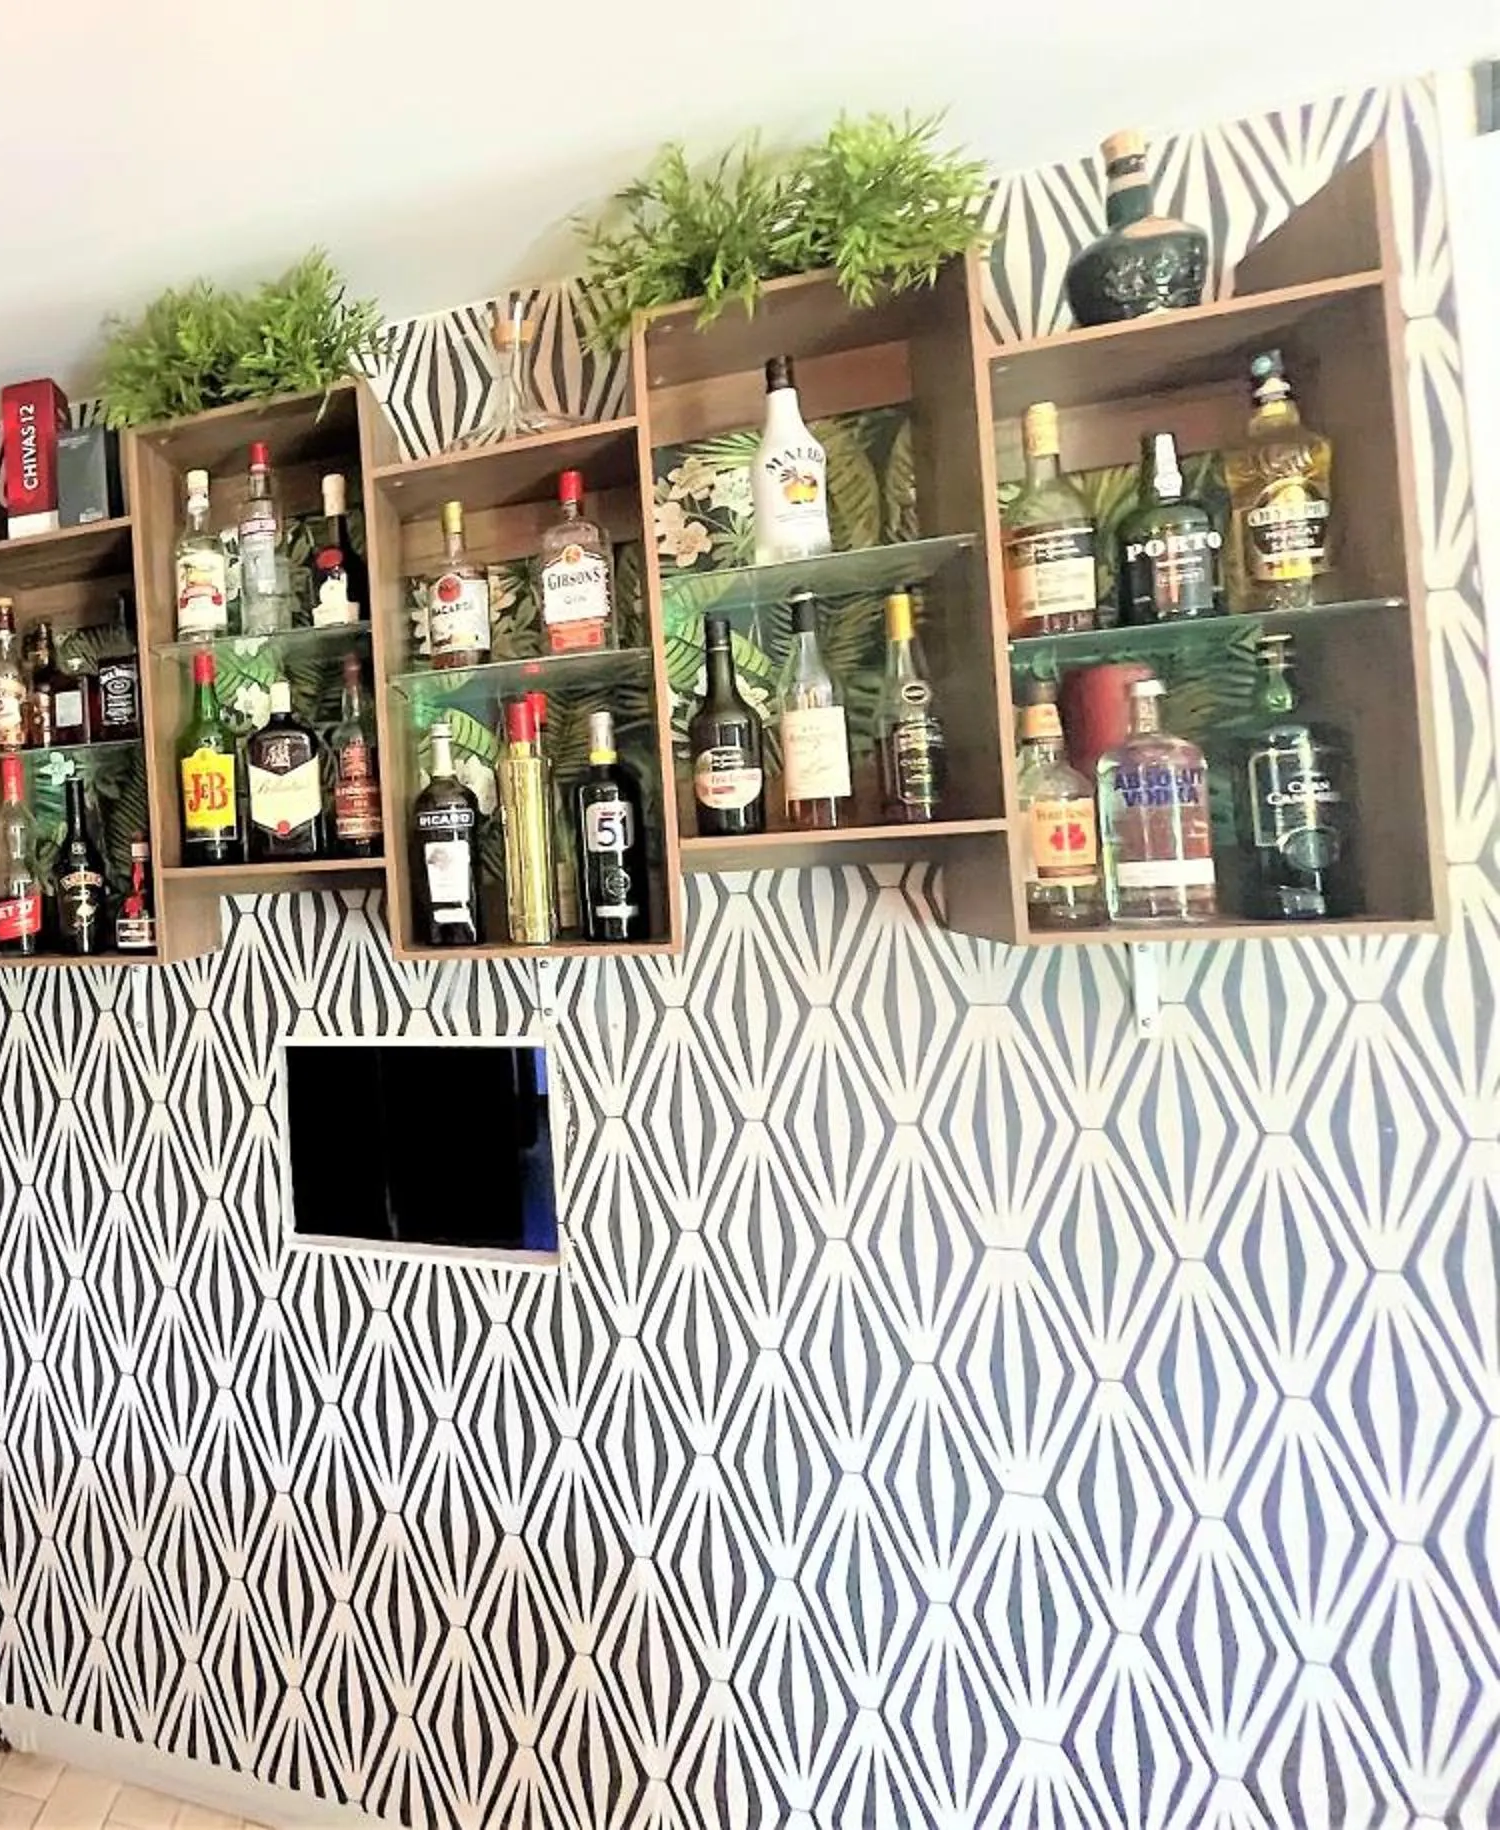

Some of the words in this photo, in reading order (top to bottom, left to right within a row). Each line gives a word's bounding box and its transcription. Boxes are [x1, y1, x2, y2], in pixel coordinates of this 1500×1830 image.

[19, 402, 36, 423] 12
[20, 425, 40, 490] CHIVAS
[1126, 531, 1222, 562] PORTO
[597, 815, 629, 847] 51
